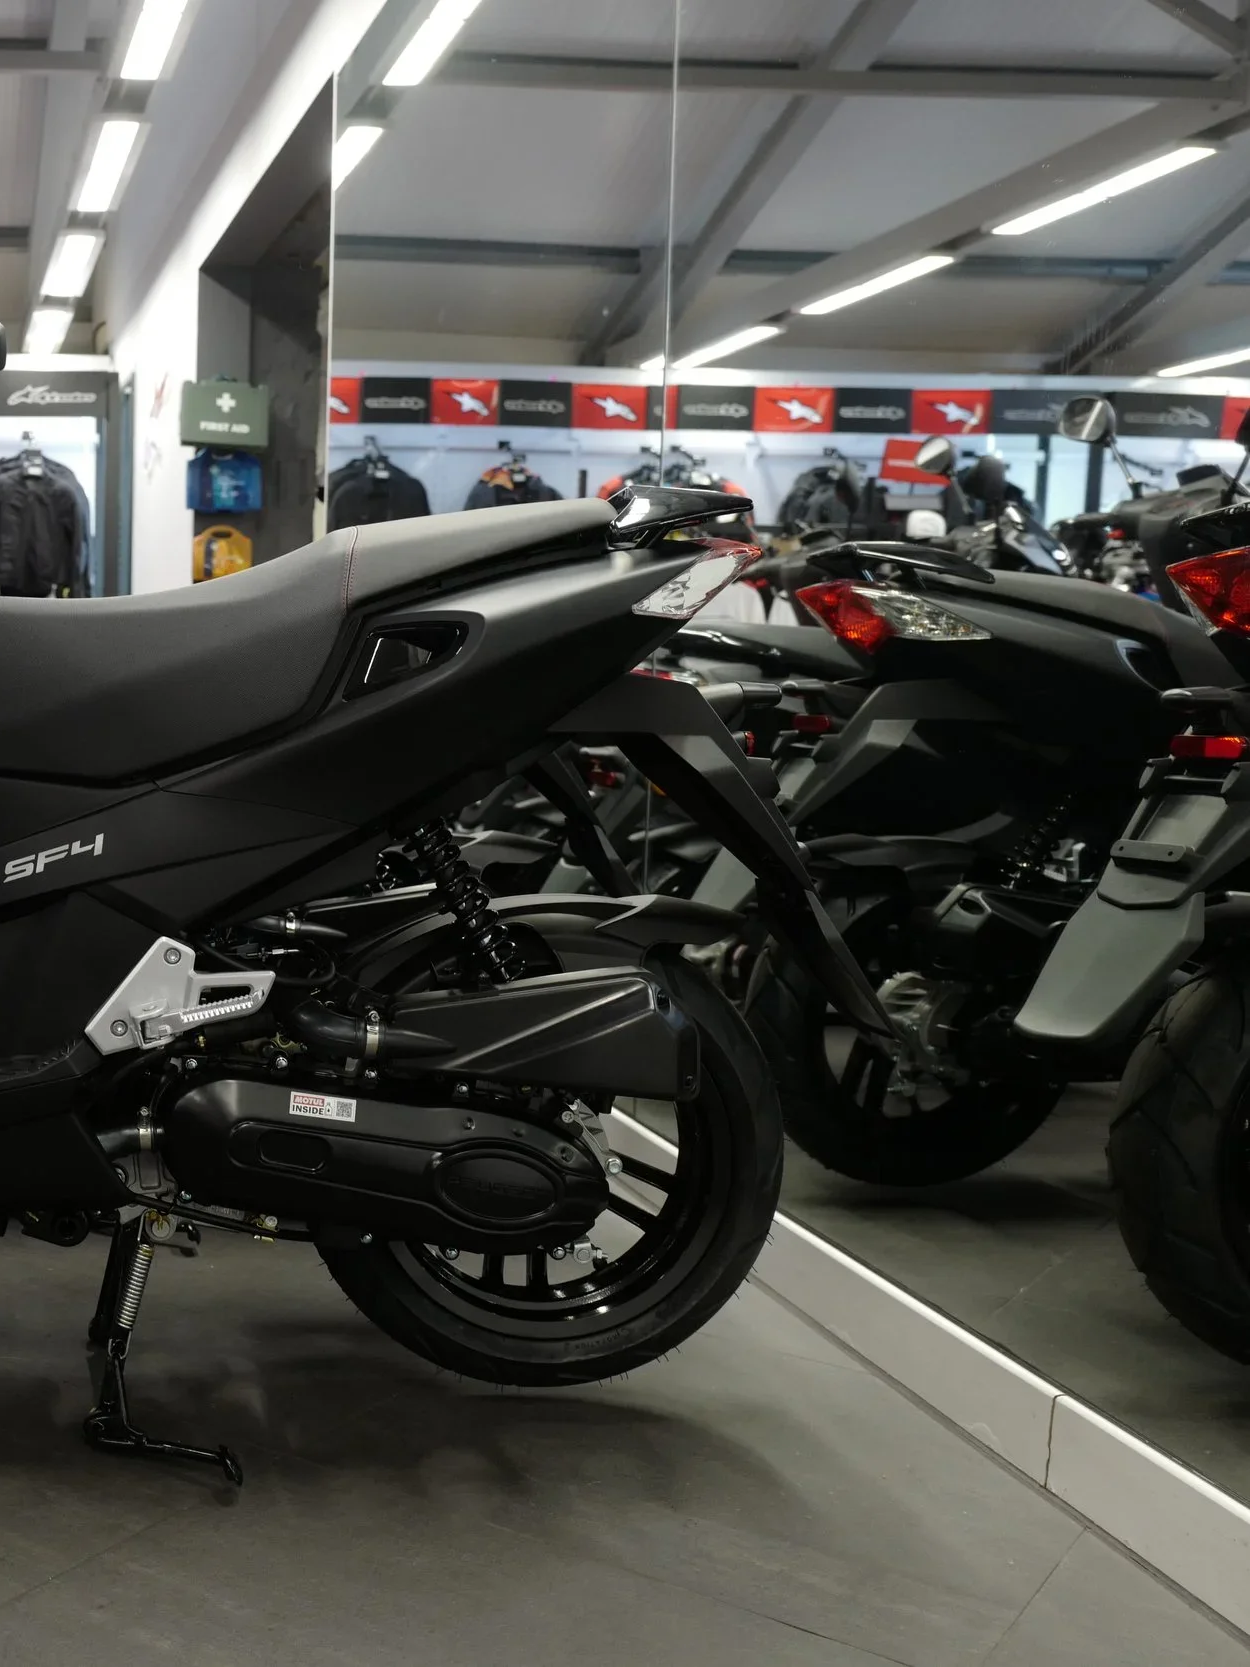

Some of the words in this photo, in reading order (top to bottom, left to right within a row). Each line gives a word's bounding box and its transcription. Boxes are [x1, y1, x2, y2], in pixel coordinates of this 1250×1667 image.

[199, 421, 230, 433] FIRST
[3, 833, 104, 883] SF4
[294, 1095, 324, 1106] MOTUL
[292, 1105, 324, 1115] INSIDE
